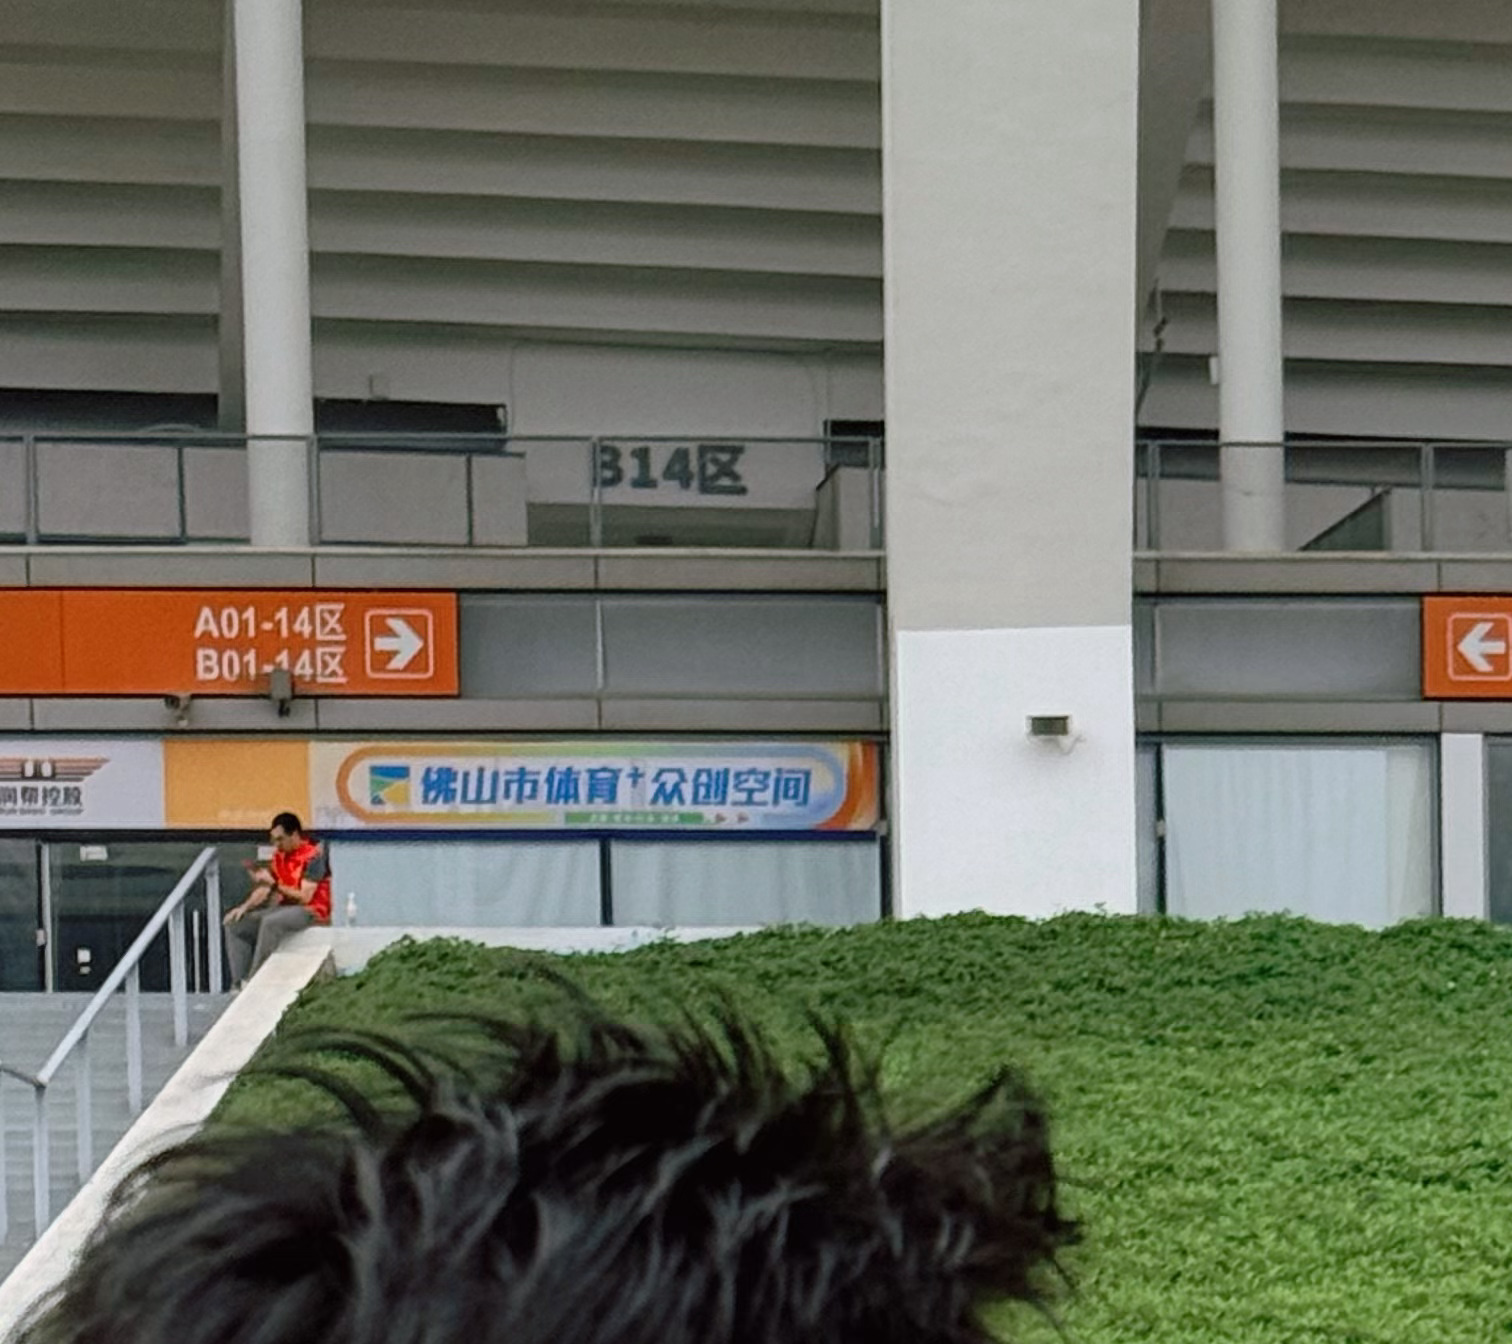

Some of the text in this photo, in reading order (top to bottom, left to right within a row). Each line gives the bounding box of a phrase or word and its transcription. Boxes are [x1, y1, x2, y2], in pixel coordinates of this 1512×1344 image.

[592, 445, 748, 495] B14区
[194, 603, 347, 641] A01-14区
[196, 646, 348, 683] B01-14区
